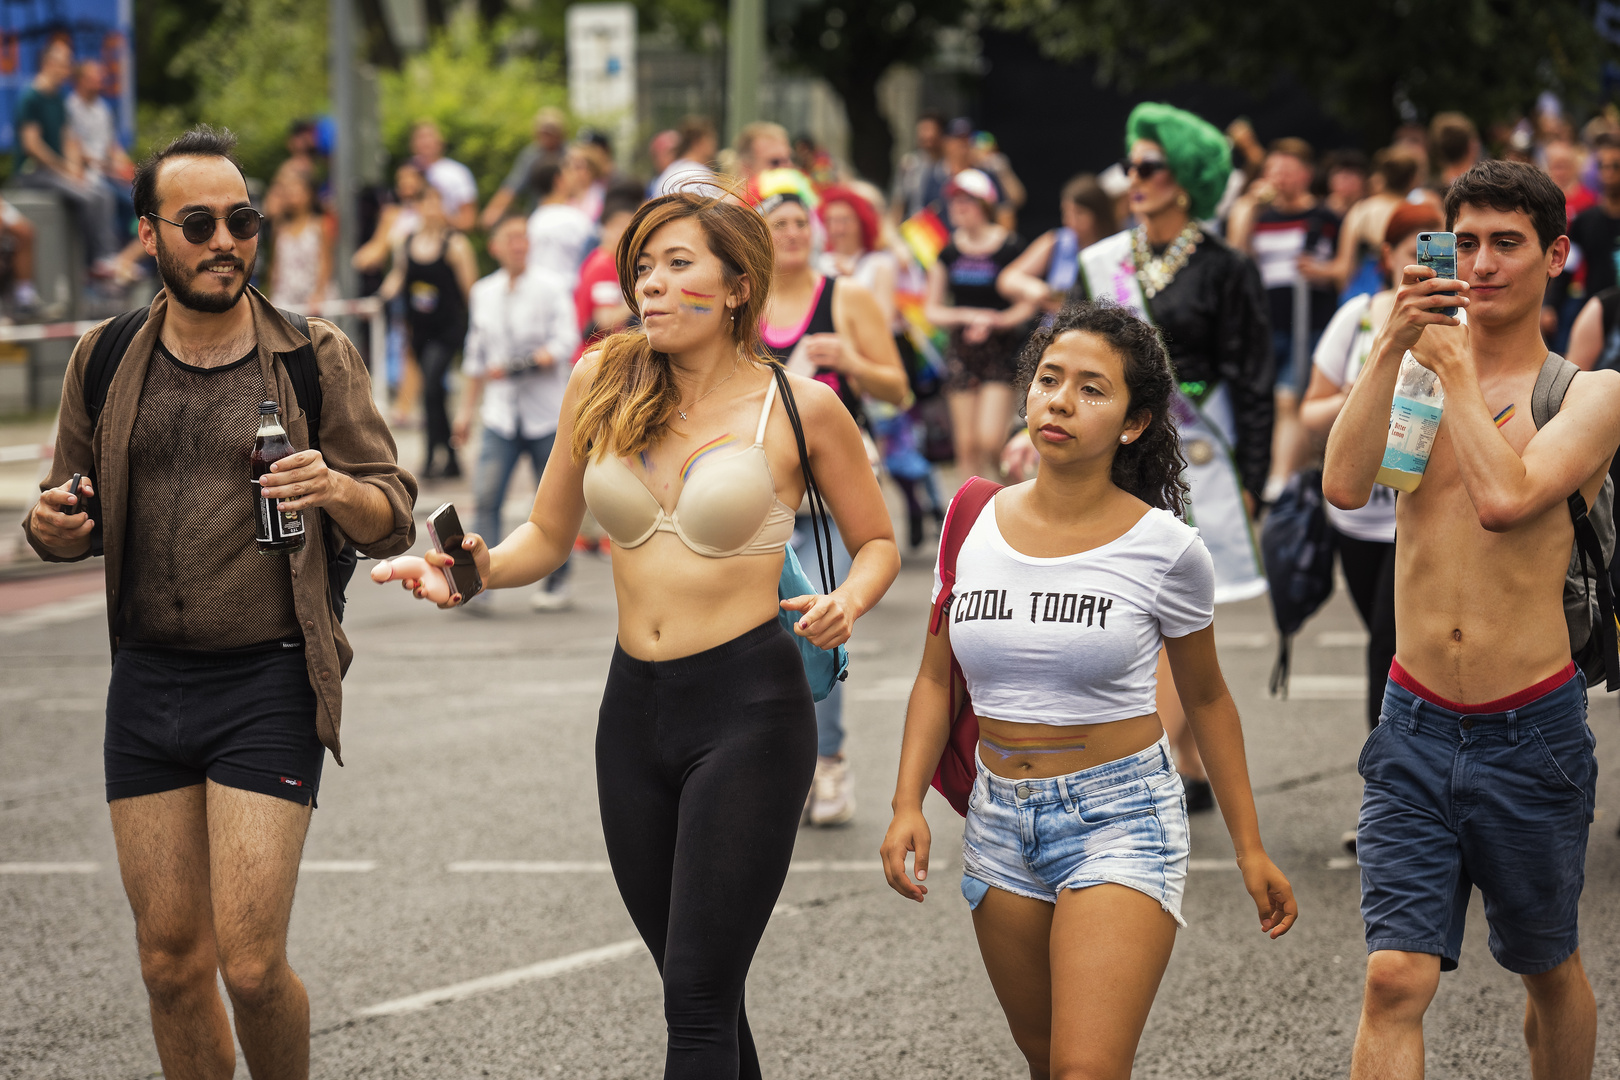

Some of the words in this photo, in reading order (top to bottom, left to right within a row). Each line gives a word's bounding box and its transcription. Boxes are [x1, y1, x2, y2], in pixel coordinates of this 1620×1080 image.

[1394, 422, 1407, 432] Bitter
[1391, 429, 1405, 439] Lemon
[955, 590, 1013, 624] COOL
[1030, 592, 1113, 630] TODAY
